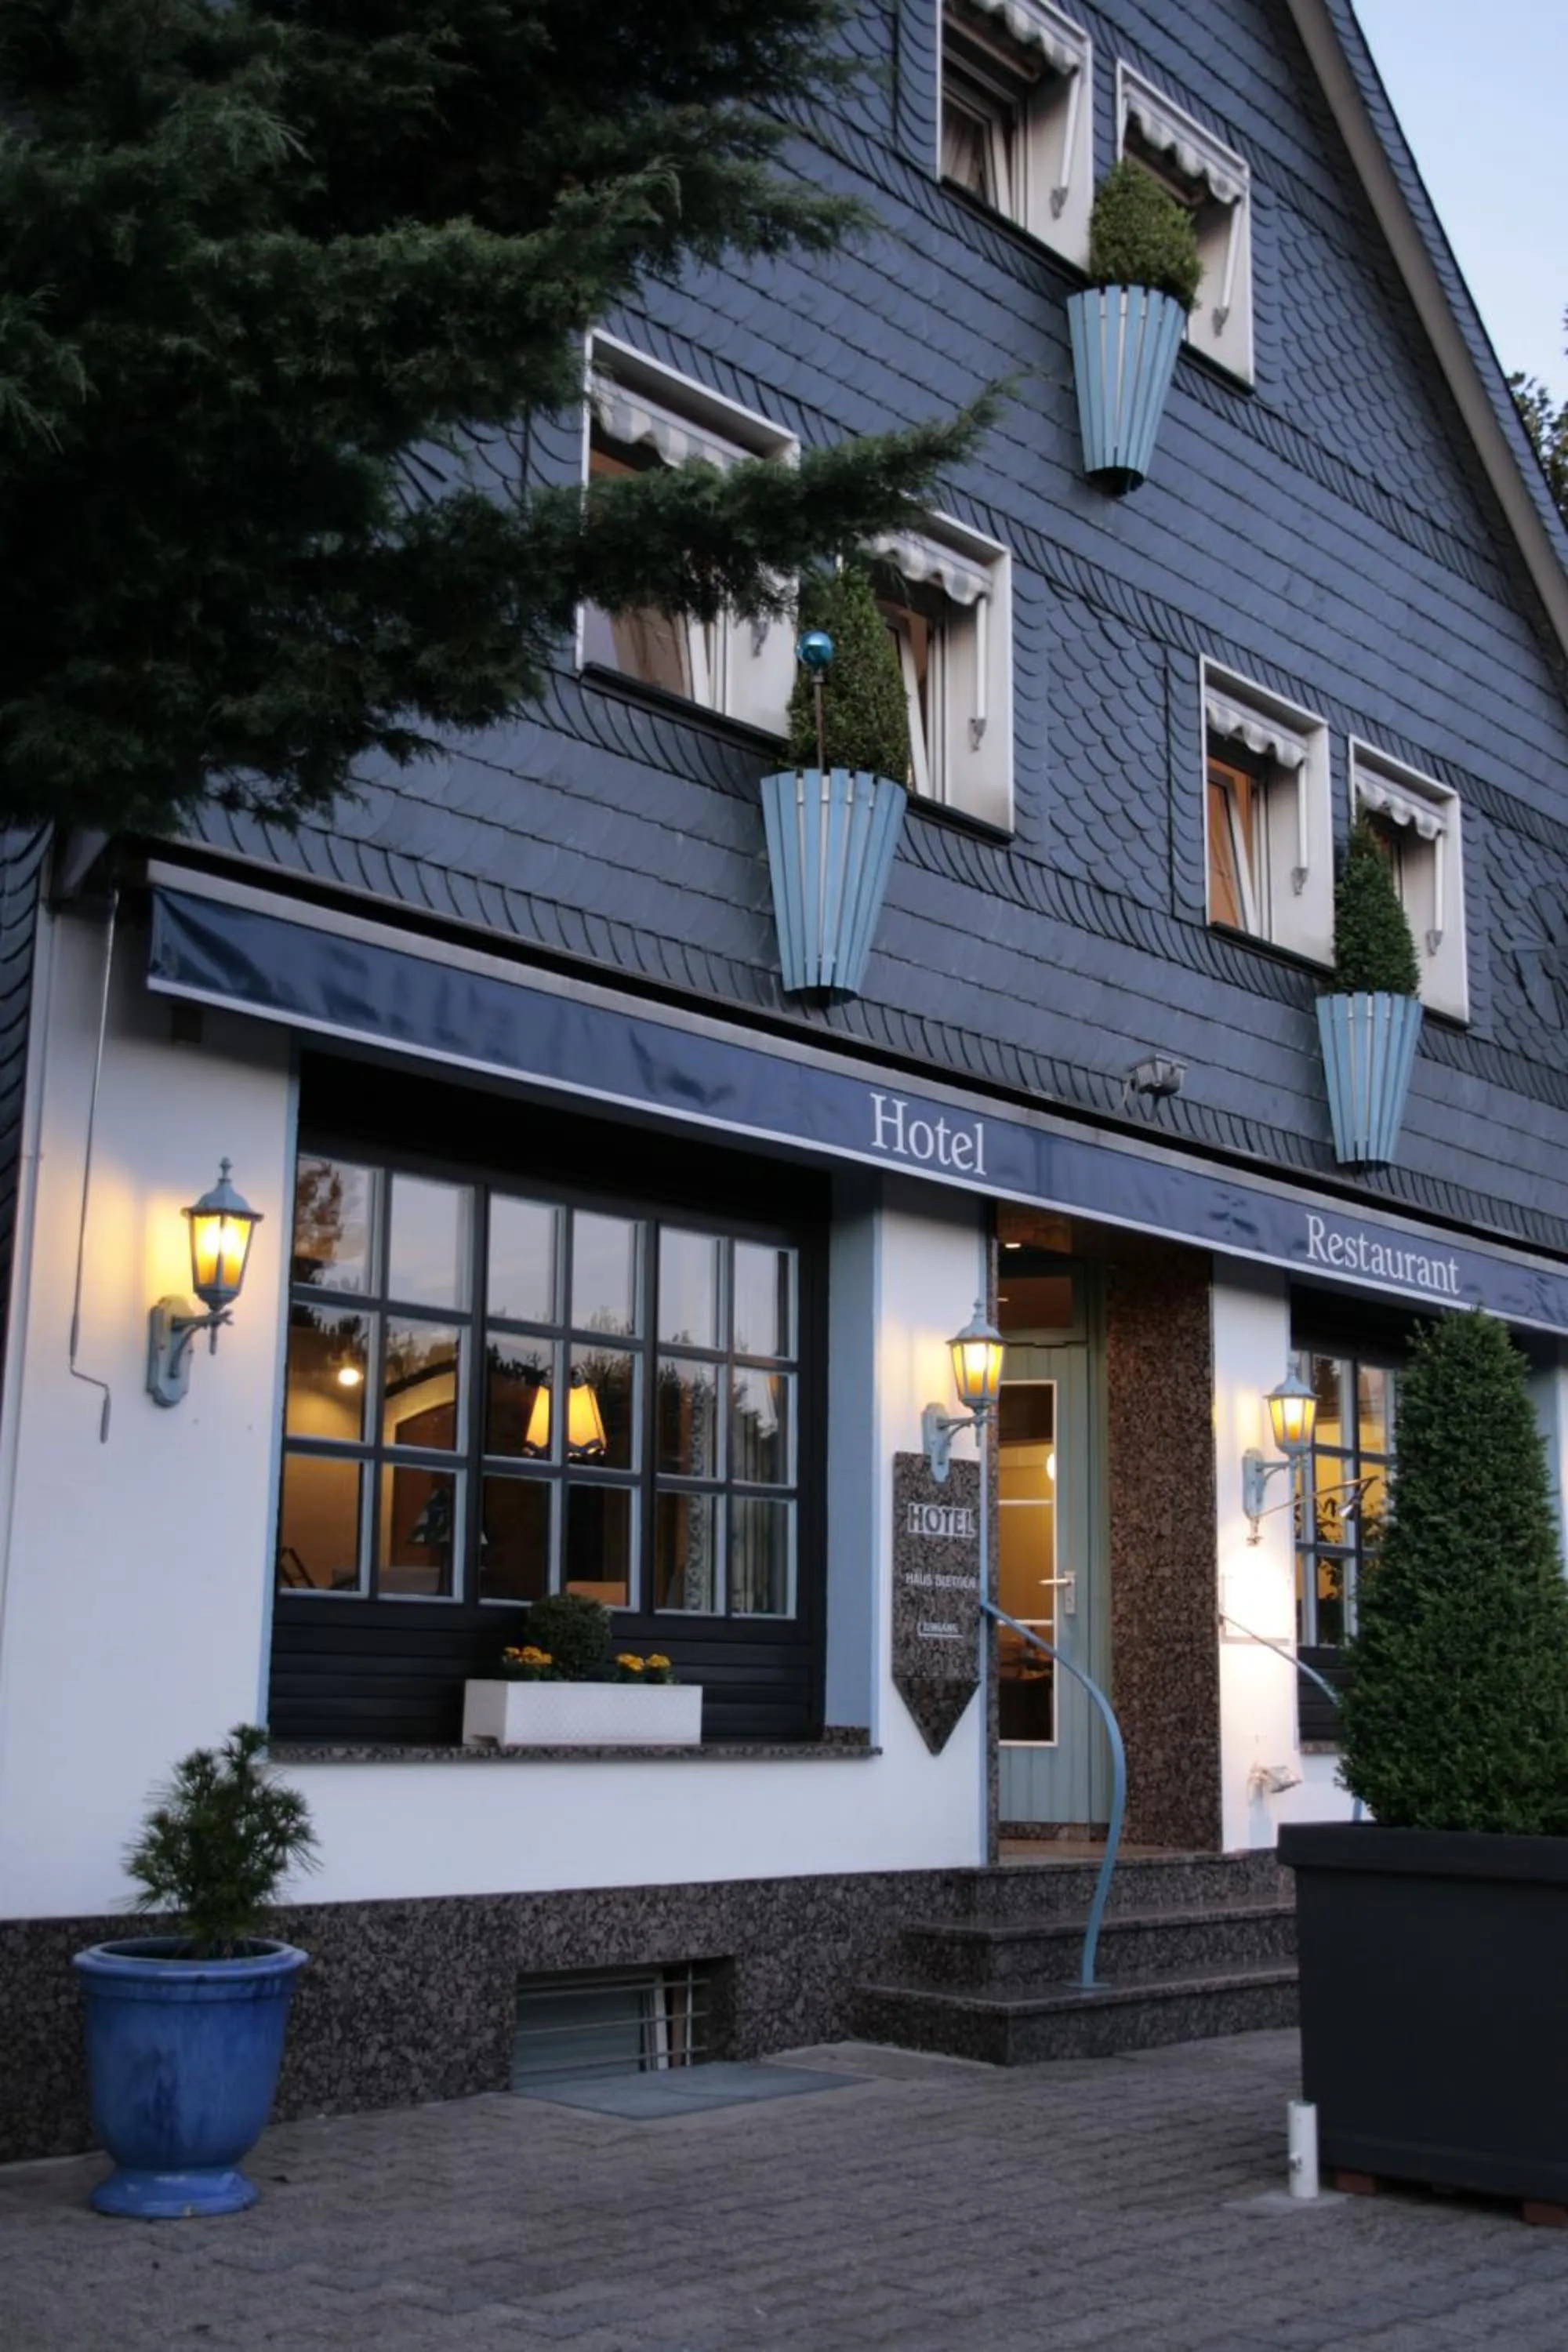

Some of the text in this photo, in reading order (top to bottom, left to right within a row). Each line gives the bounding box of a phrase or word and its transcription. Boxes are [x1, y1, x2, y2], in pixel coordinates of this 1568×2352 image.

[869, 1091, 988, 1176] Hotel
[1305, 1213, 1462, 1295] Restaurant
[908, 1503, 976, 1537] HOTEL
